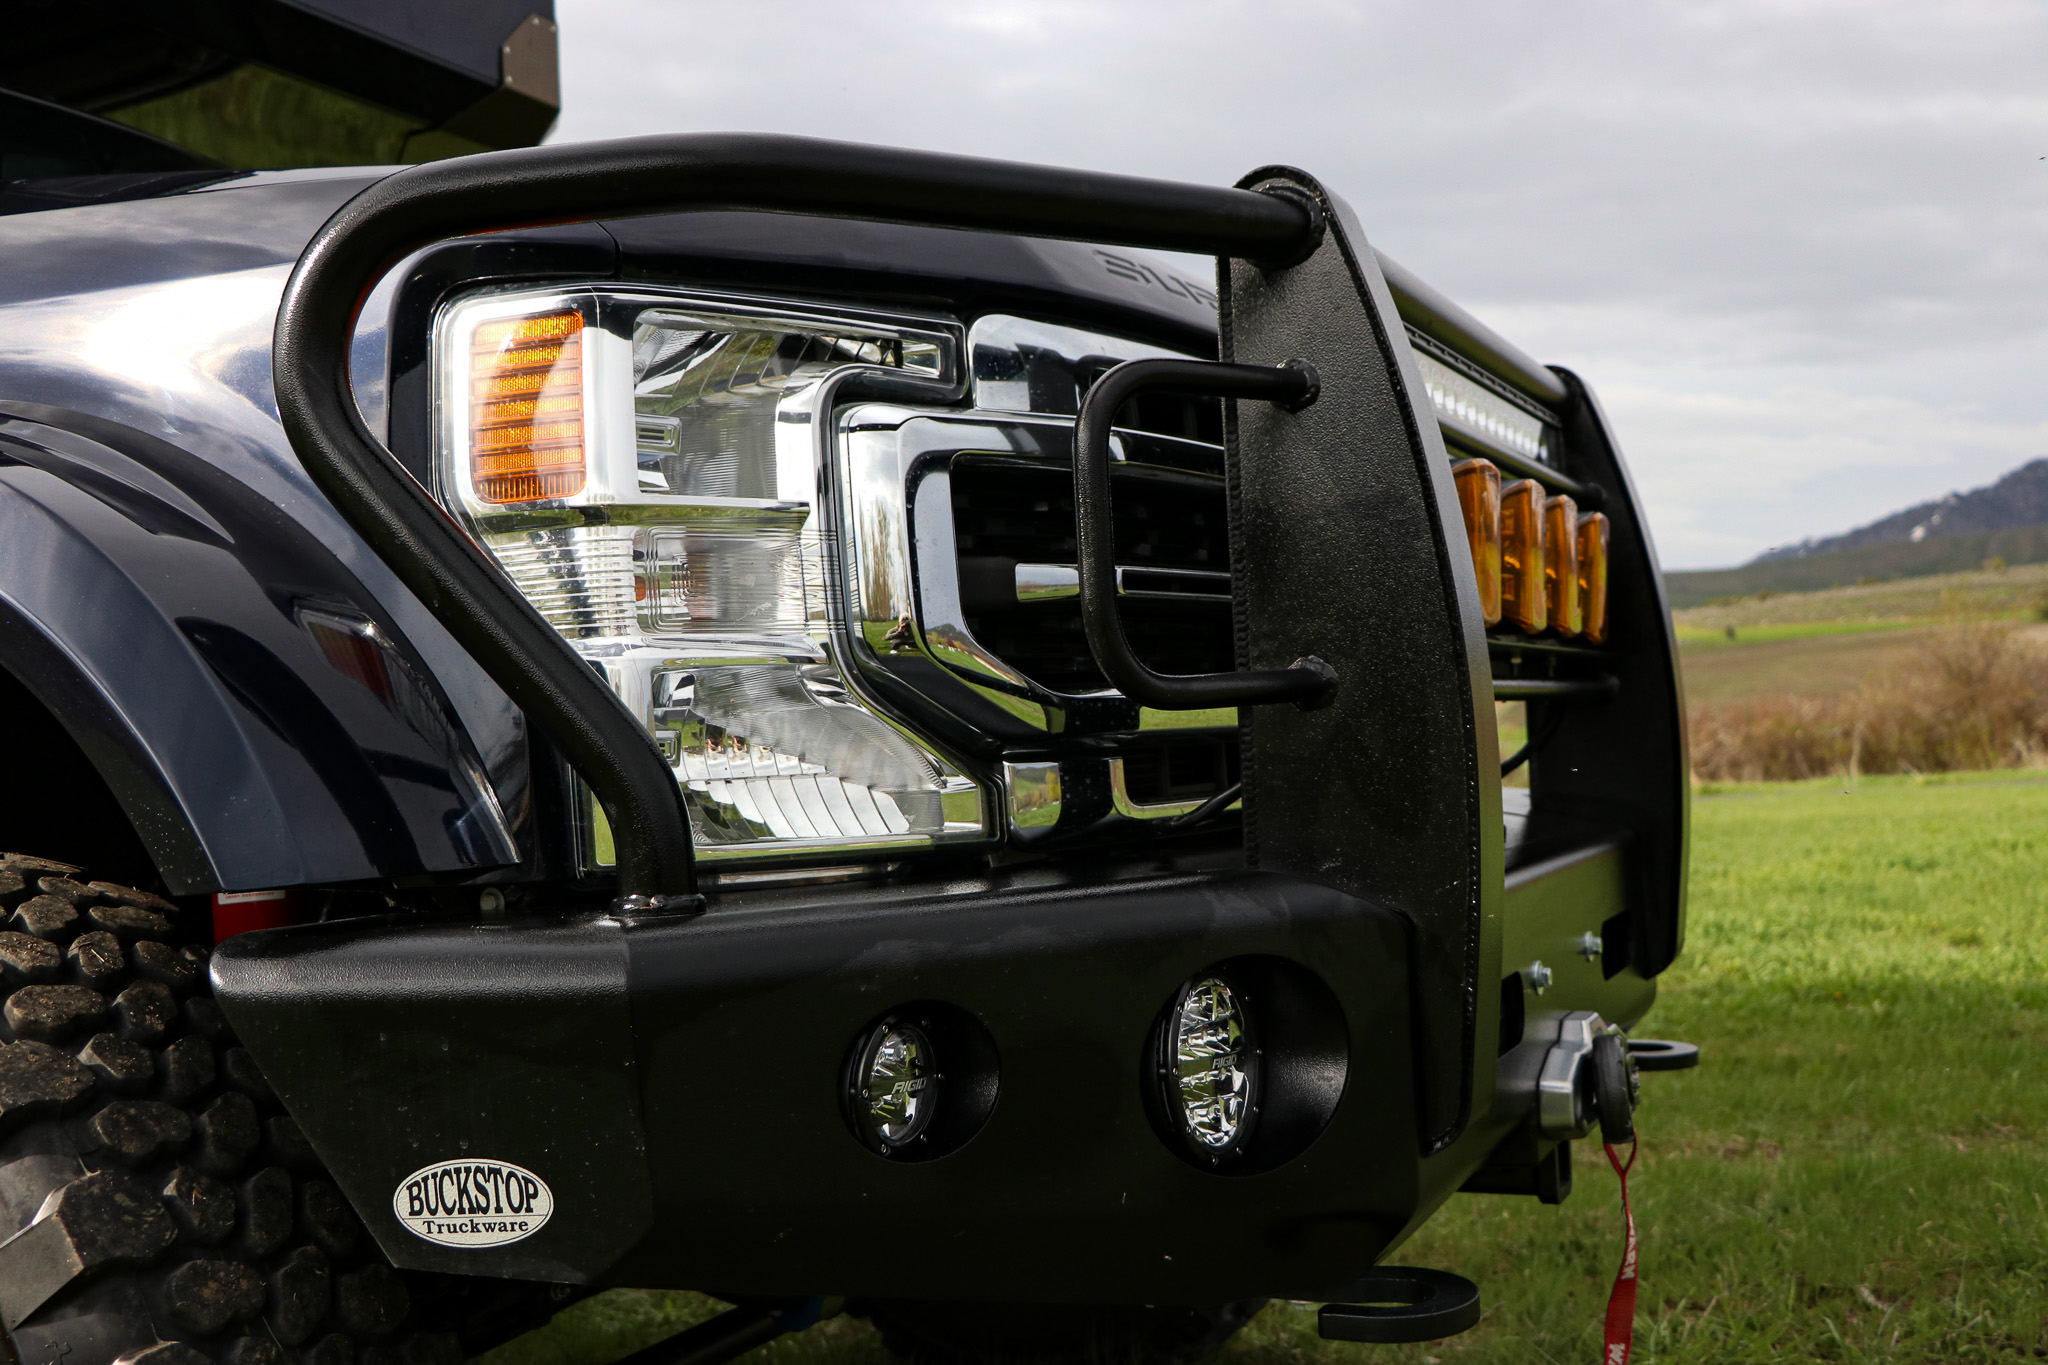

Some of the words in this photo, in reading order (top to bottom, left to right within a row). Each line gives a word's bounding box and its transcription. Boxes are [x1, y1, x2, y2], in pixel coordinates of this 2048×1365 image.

[1212, 1054, 1237, 1070] RIGID
[891, 1077, 927, 1094] RIGID
[406, 1165, 539, 1217] BUCKSTOP
[422, 1219, 529, 1234] Truckware
